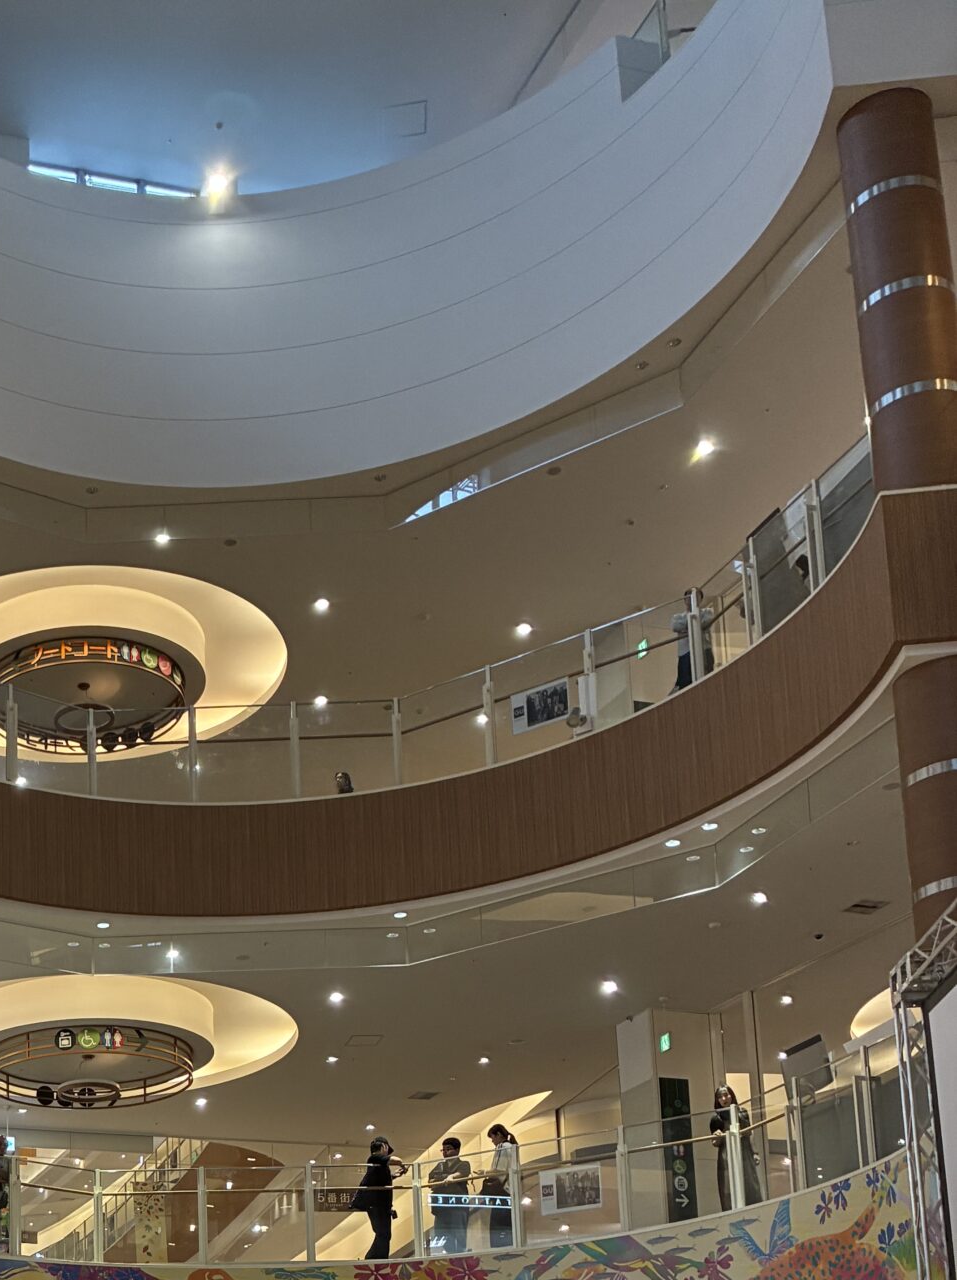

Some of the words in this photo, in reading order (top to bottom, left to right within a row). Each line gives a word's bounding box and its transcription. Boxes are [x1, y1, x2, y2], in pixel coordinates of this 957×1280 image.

[30, 639, 119, 665] フードコート
